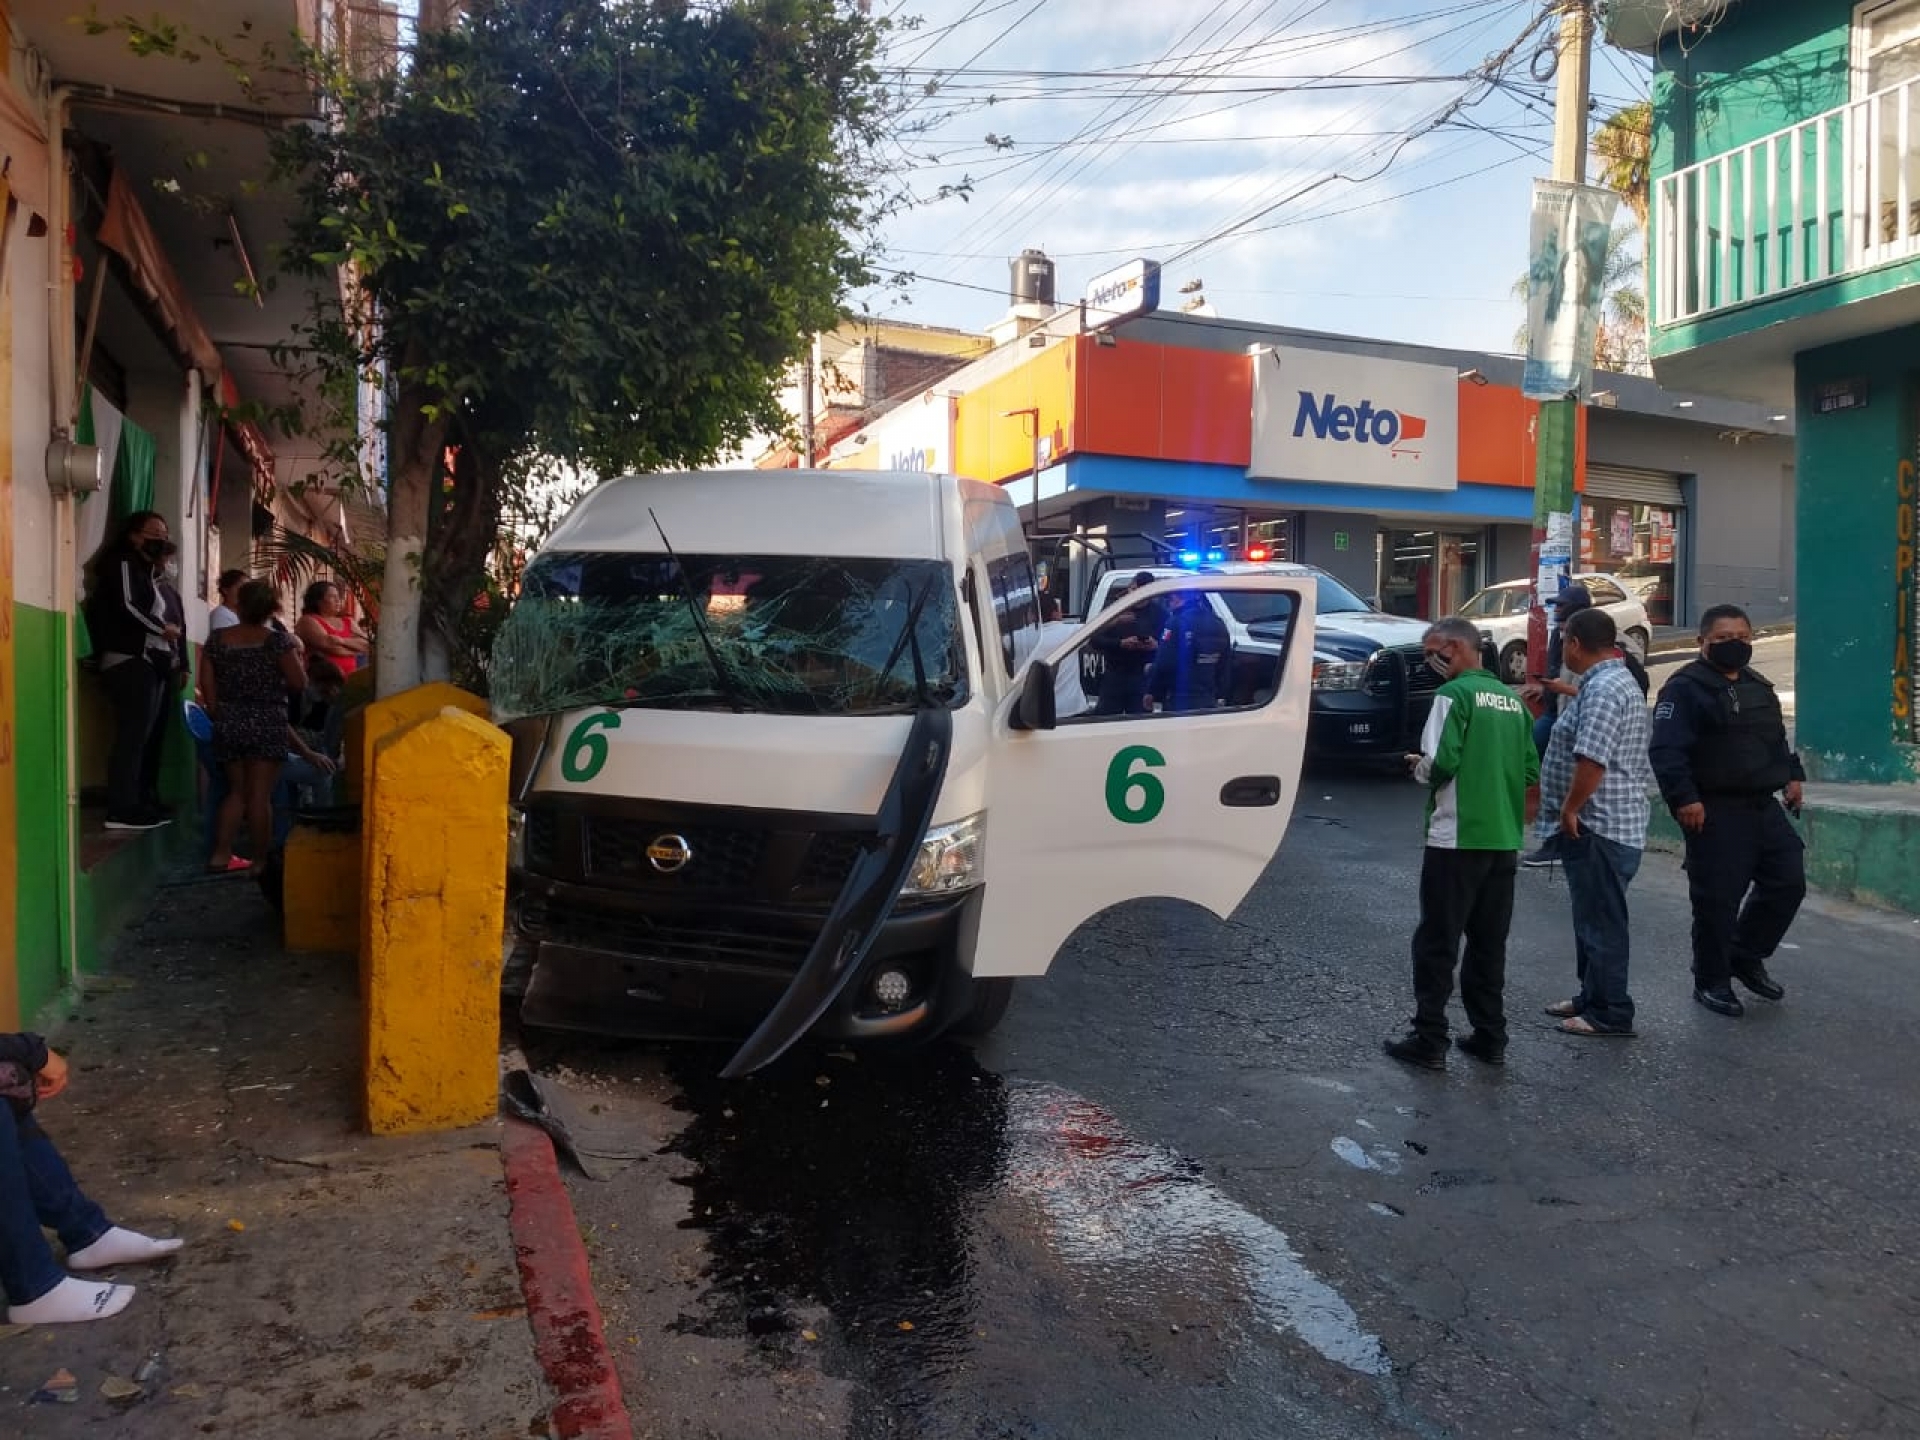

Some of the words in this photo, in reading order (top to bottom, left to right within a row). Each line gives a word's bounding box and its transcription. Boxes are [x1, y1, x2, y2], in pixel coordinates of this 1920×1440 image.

[1093, 281, 1127, 308] Neto
[1293, 390, 1398, 445] Neto
[1893, 458, 1914, 719] COPIAS
[562, 712, 621, 783] 6
[1105, 744, 1167, 824] 6
